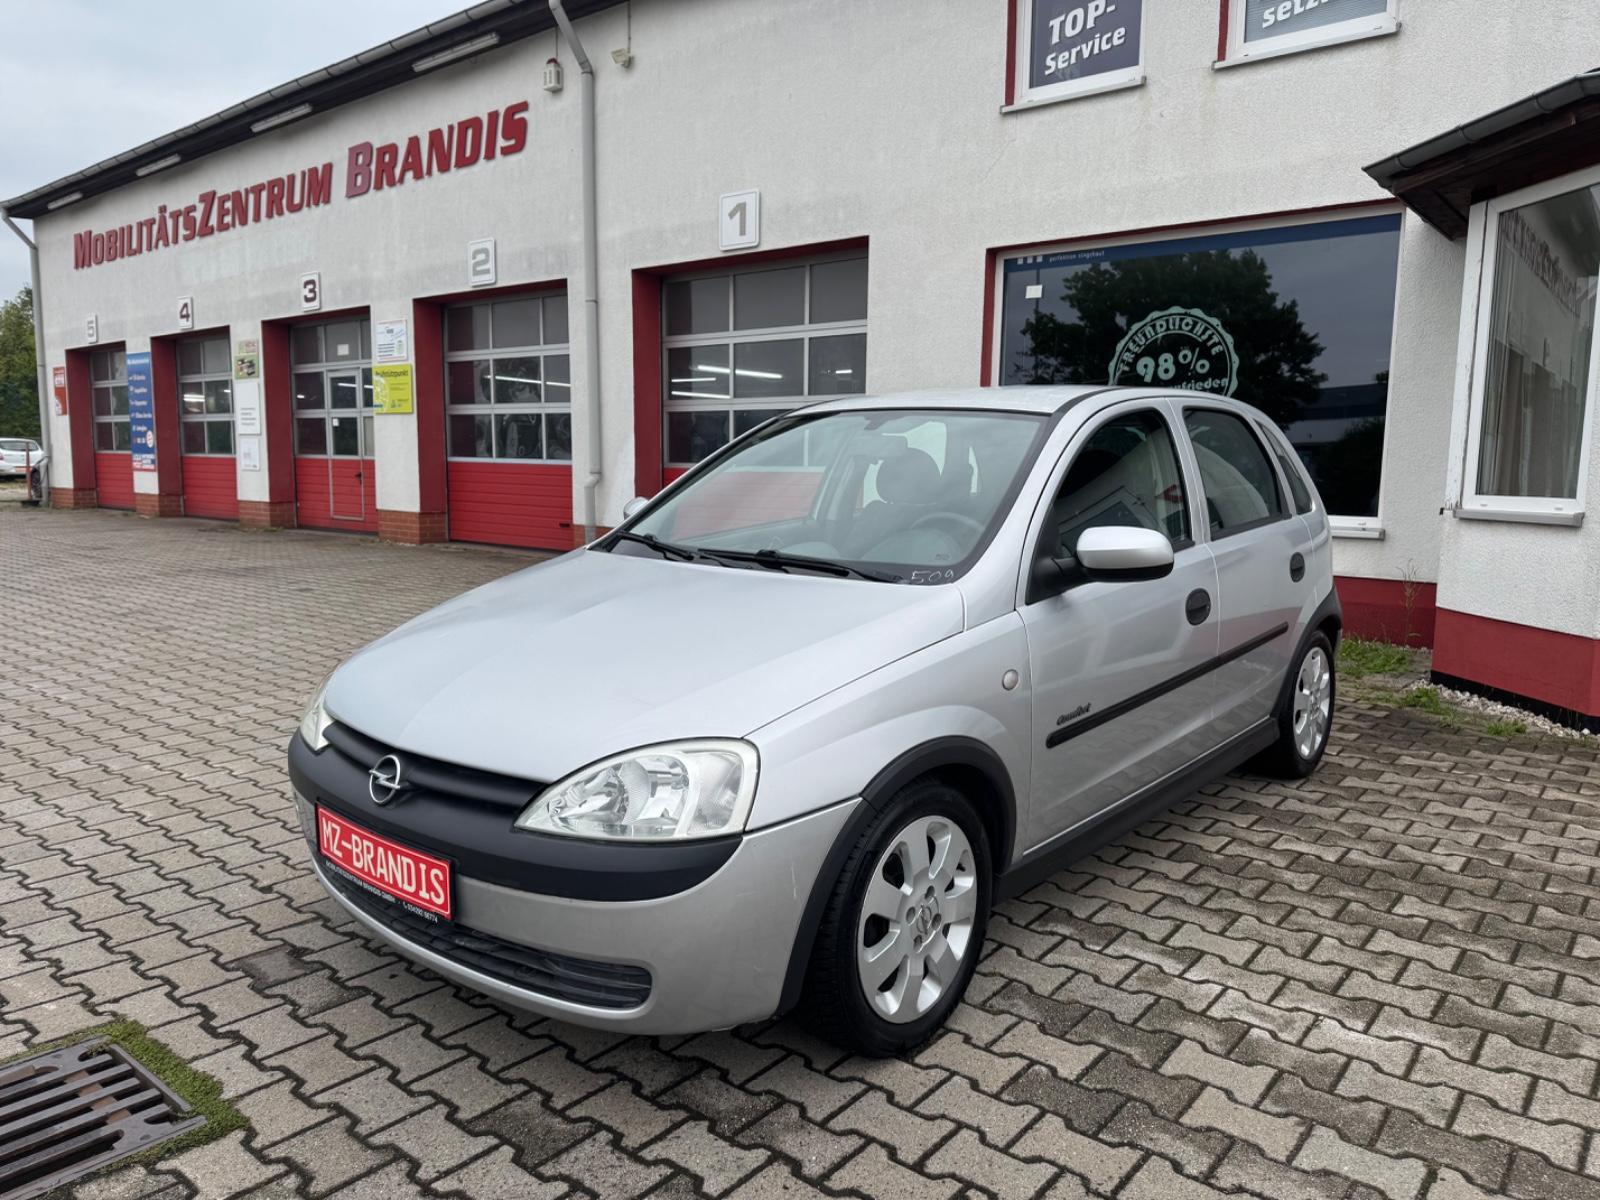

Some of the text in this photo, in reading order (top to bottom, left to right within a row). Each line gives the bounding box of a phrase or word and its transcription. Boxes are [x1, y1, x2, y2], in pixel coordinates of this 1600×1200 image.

[1048, 0, 1116, 45] TOP-
[1044, 26, 1126, 76] Service
[728, 202, 747, 236] 1
[471, 247, 491, 277] 2
[303, 278, 318, 303] 3
[179, 301, 191, 322] 4
[1119, 315, 1224, 372] FREUNDLICHSTE
[1135, 346, 1210, 383] 98%
[322, 816, 445, 906] MZ-BRANDIS
